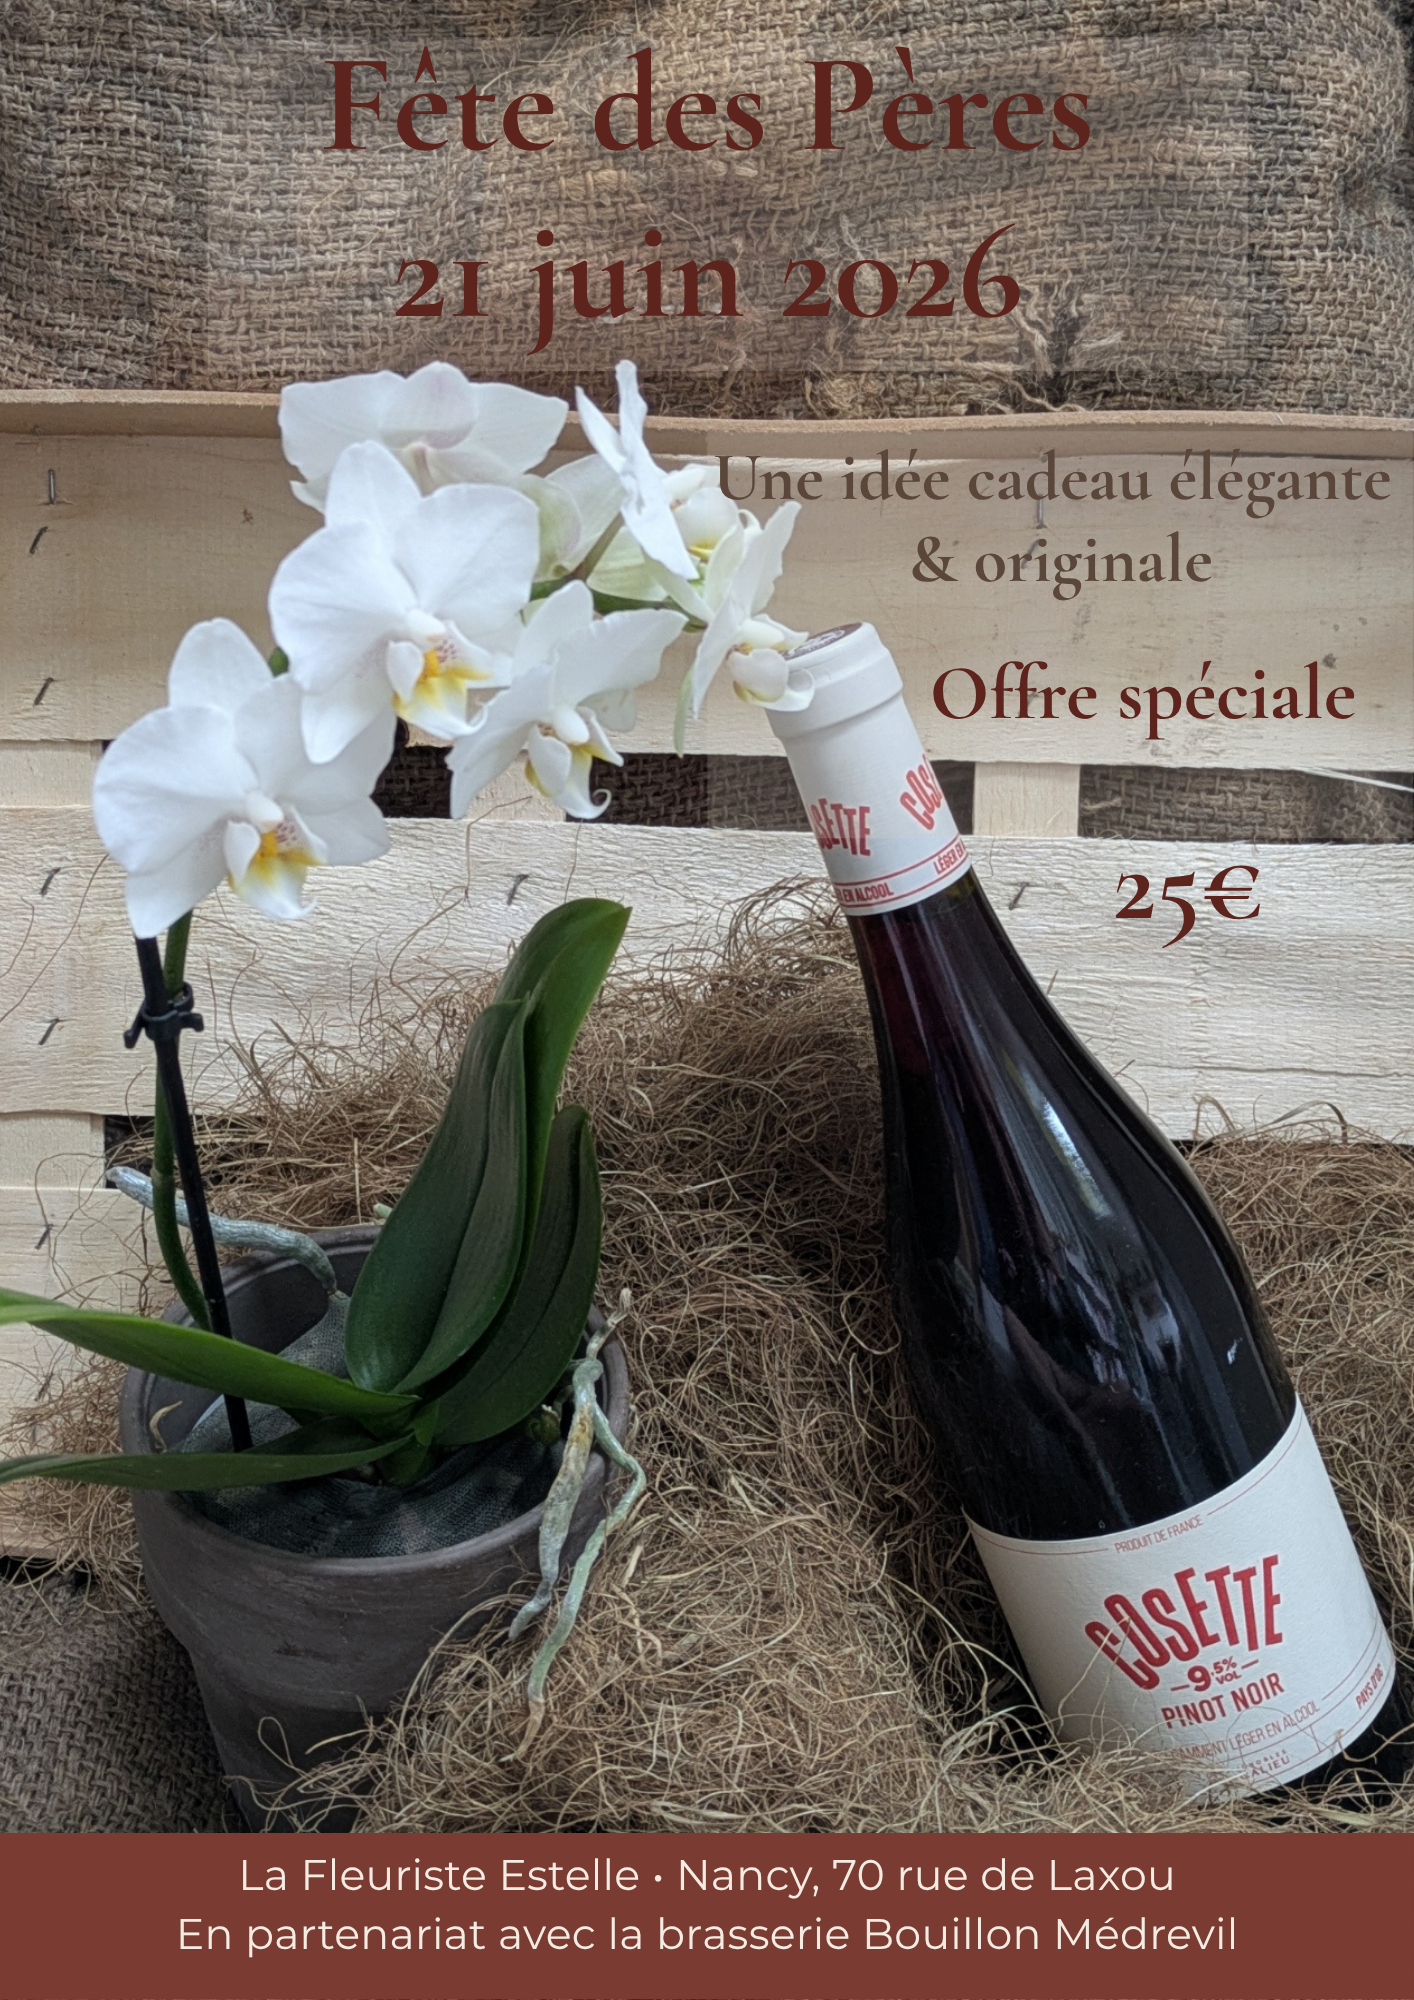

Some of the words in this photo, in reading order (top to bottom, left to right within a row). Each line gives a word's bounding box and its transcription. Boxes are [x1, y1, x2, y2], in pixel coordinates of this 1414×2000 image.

[811, 798, 871, 856] SETTE
[933, 848, 958, 875] LÉGER
[856, 882, 895, 903] ALCOOL
[1114, 1533, 1154, 1554] PRODUIT
[1153, 1529, 1168, 1543] DE
[1167, 1514, 1204, 1538] FRANCE
[1084, 1554, 1283, 1690] COSETTE
[1215, 1670, 1242, 1685] VOL
[1355, 1681, 1373, 1710] PAYS
[1161, 1694, 1227, 1729] PINOT
[1230, 1672, 1285, 1712] NOIR
[1229, 1727, 1267, 1750] LÉGER
[1264, 1720, 1282, 1737] EN
[1283, 1700, 1320, 1730] ALCOOL
